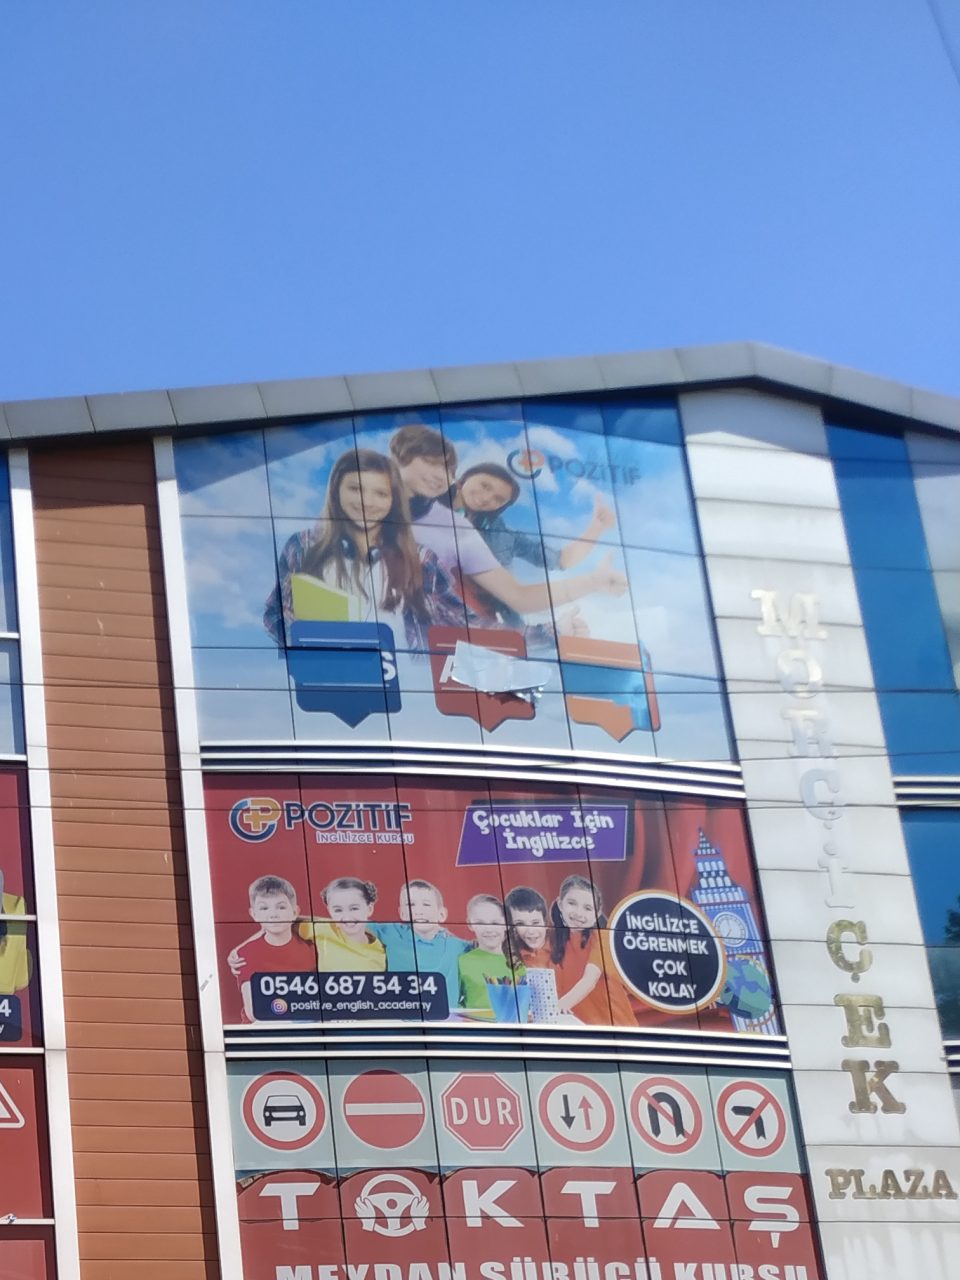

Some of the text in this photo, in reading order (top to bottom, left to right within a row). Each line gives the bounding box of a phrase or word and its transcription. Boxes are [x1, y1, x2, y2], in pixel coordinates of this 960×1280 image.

[472, 806, 615, 835] Çocuklar İçin
[316, 831, 415, 844] İNGİLİZCE KURSU
[503, 828, 596, 857] İngilizce
[625, 910, 700, 936] İNGİLİZCE
[622, 931, 709, 956] ÖĞRENMEK
[652, 959, 688, 979] ÇOK
[260, 976, 438, 996] 0546 687 54 34
[648, 981, 698, 1000] KOLAY
[290, 1000, 432, 1014] positive_english_academy
[450, 1097, 515, 1125] DUR
[825, 1168, 959, 1201] PLAZA
